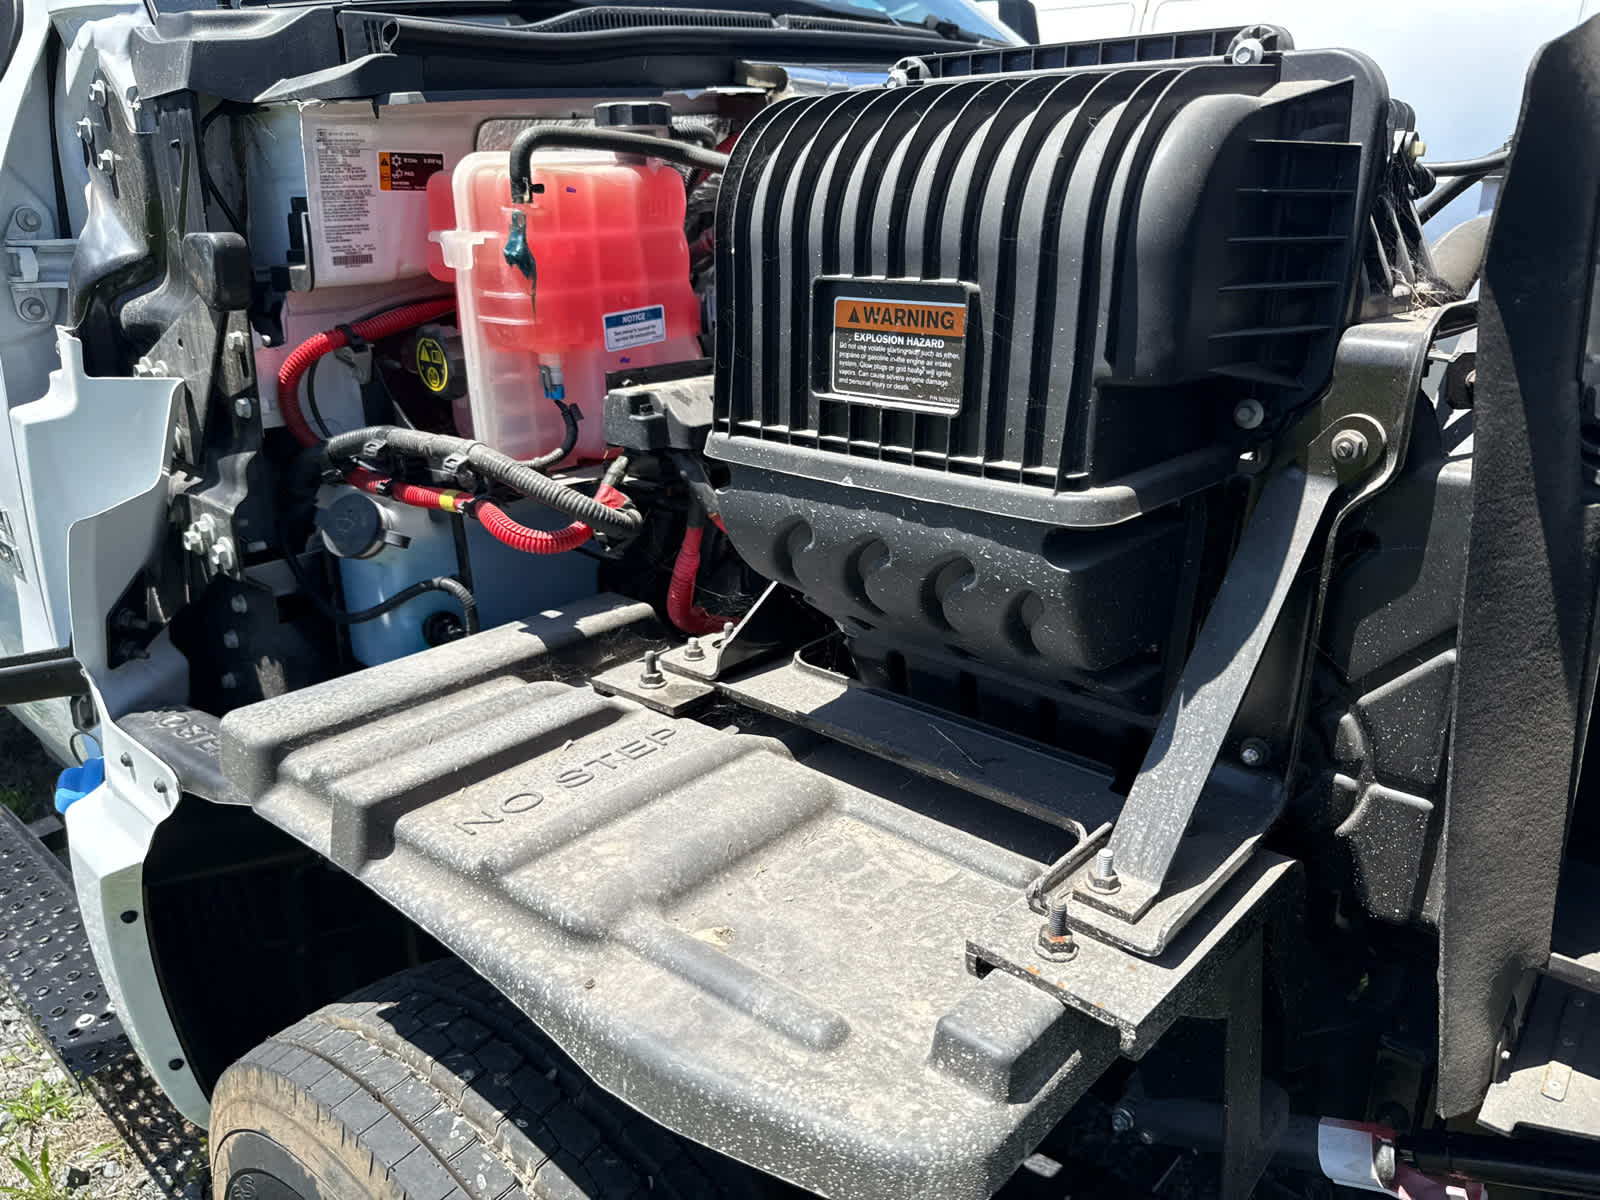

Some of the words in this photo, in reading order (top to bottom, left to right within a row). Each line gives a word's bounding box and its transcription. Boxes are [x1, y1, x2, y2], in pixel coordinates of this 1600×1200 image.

[622, 312, 646, 324] NOTICE
[863, 306, 954, 330] WARNING
[854, 332, 904, 346] EXPLOSION
[906, 336, 945, 349] HAZARD
[860, 361, 873, 369] Glow
[874, 363, 888, 372] plugs
[906, 358, 925, 366] engine
[906, 376, 925, 384] engine
[453, 792, 544, 836] NO
[556, 728, 677, 789] STEP
